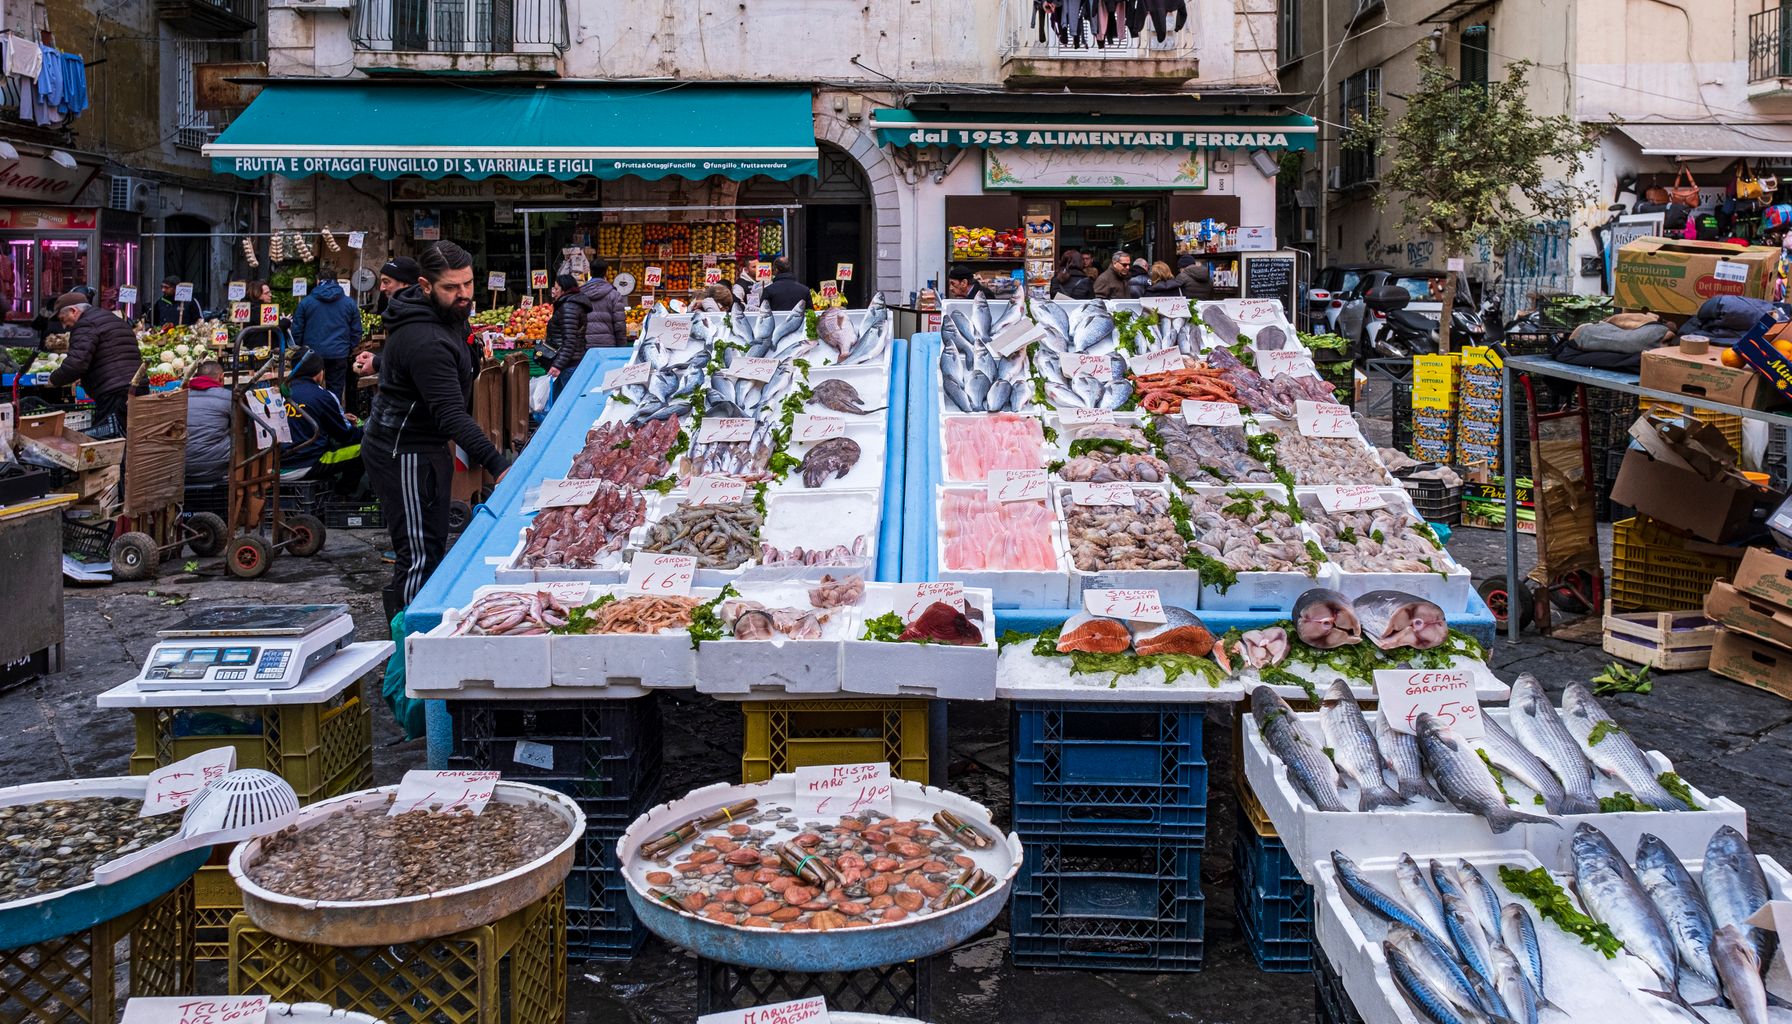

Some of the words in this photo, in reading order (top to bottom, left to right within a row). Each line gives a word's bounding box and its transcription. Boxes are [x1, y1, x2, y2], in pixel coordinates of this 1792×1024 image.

[910, 129, 948, 143] dal
[959, 130, 1019, 145] 1953
[1026, 131, 1174, 146] ALIMENTARI
[1183, 133, 1289, 147] FERRARA
[235, 157, 286, 172] FRUTTA
[290, 158, 299, 172] E
[303, 157, 365, 172] ORTAGGI
[369, 157, 439, 172] FUNGILLO
[443, 158, 459, 172] DI
[463, 159, 475, 173] S.
[478, 158, 544, 173] VARRIALE
[548, 159, 556, 173] E
[559, 159, 593, 173] FIGLI
[1620, 263, 1670, 276] Premium
[1619, 275, 1678, 288] BANANAS
[1698, 281, 1712, 291] Del
[1713, 282, 1742, 294] Monte
